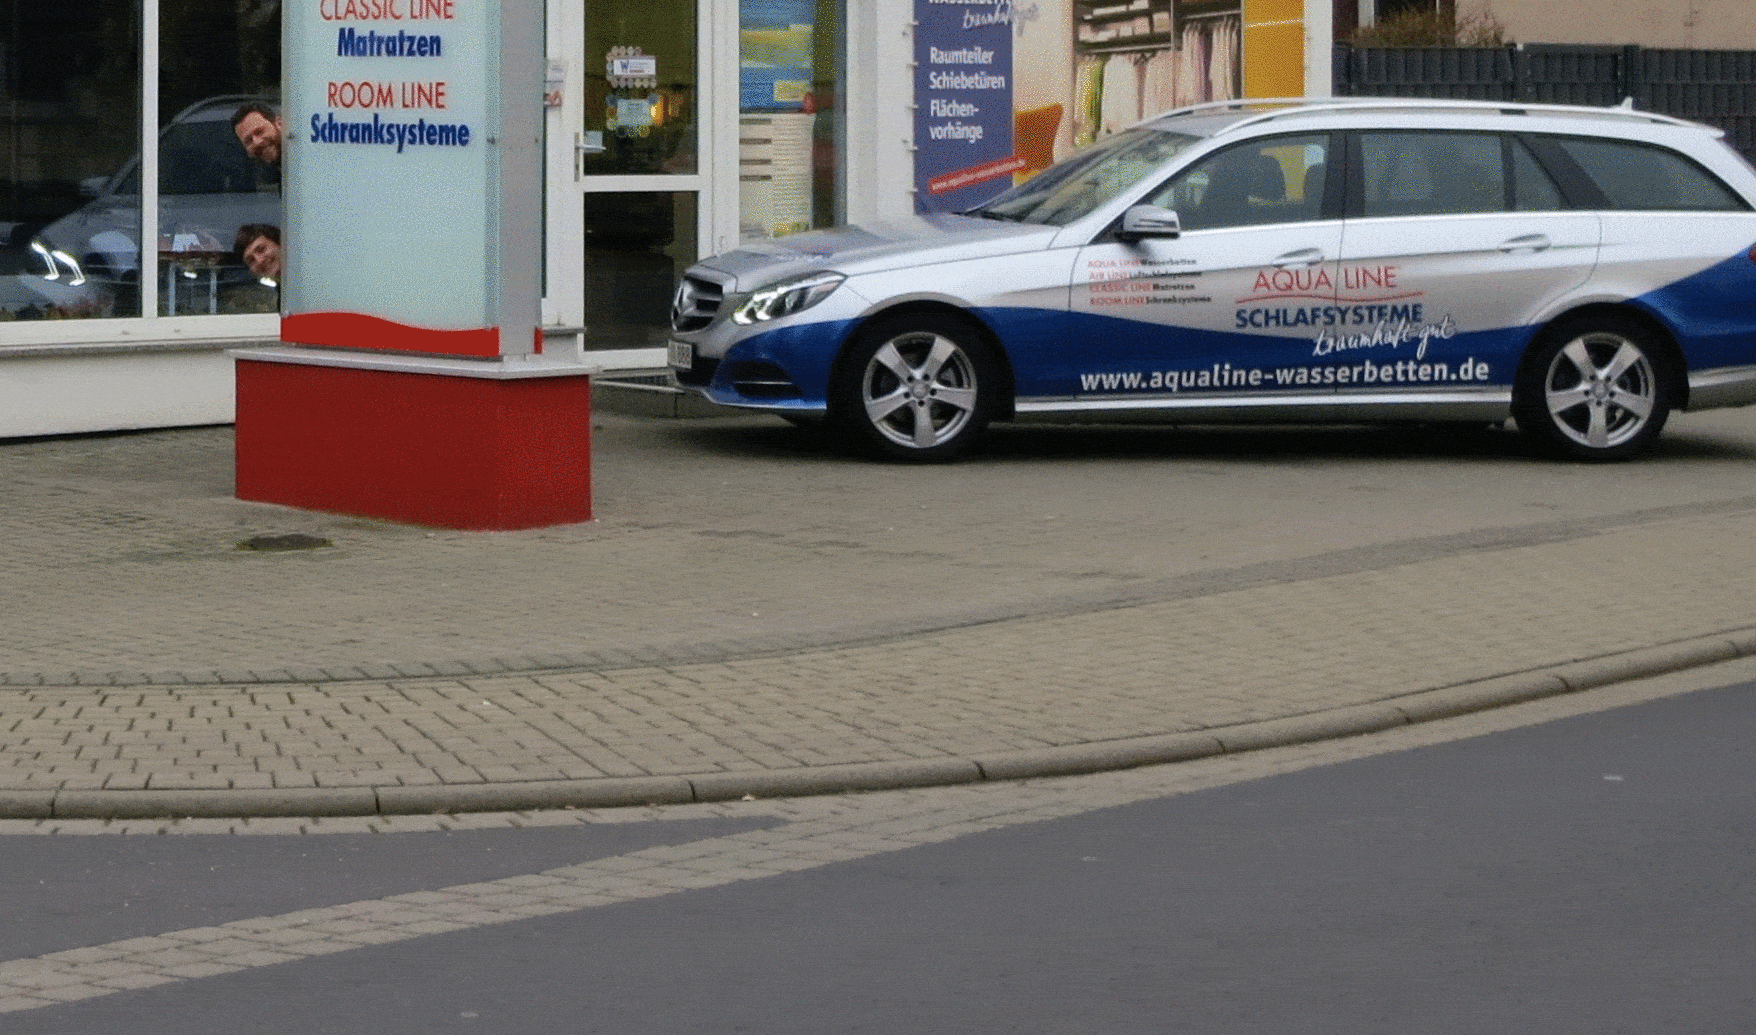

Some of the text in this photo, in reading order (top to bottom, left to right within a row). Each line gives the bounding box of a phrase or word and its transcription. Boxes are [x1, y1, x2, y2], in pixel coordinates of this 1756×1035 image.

[337, 27, 442, 57] Matratzen
[929, 46, 994, 65] Raumteiler
[929, 71, 1006, 90] Schiebetüren
[327, 81, 447, 109] ROOM LINE
[930, 99, 980, 118] Flächen-
[310, 112, 470, 154] Schranksysteme
[929, 121, 984, 144] vorhänge
[1253, 265, 1398, 292] AQUA LINE
[1235, 303, 1424, 329] SCHLAFSYSTEME
[1312, 313, 1457, 360] traumhaft gut
[1080, 356, 1490, 393] www.aqualine-wasserbetten.de
